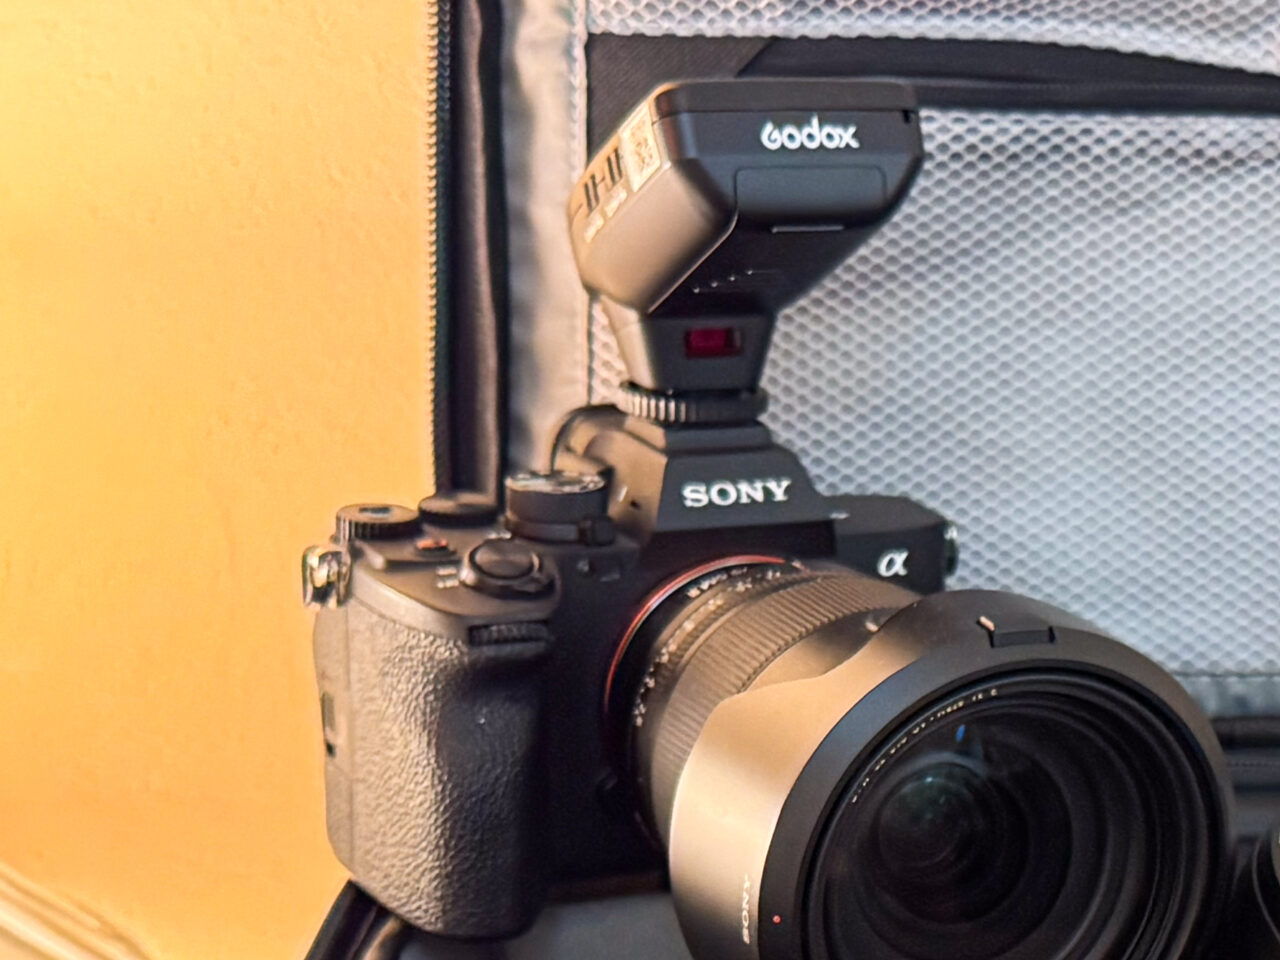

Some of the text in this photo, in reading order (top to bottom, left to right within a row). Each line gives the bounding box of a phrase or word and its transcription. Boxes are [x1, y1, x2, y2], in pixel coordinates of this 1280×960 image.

[761, 113, 860, 150] Godox
[682, 477, 791, 507] SONY
[878, 549, 909, 577] α
[742, 872, 751, 945] SONY
